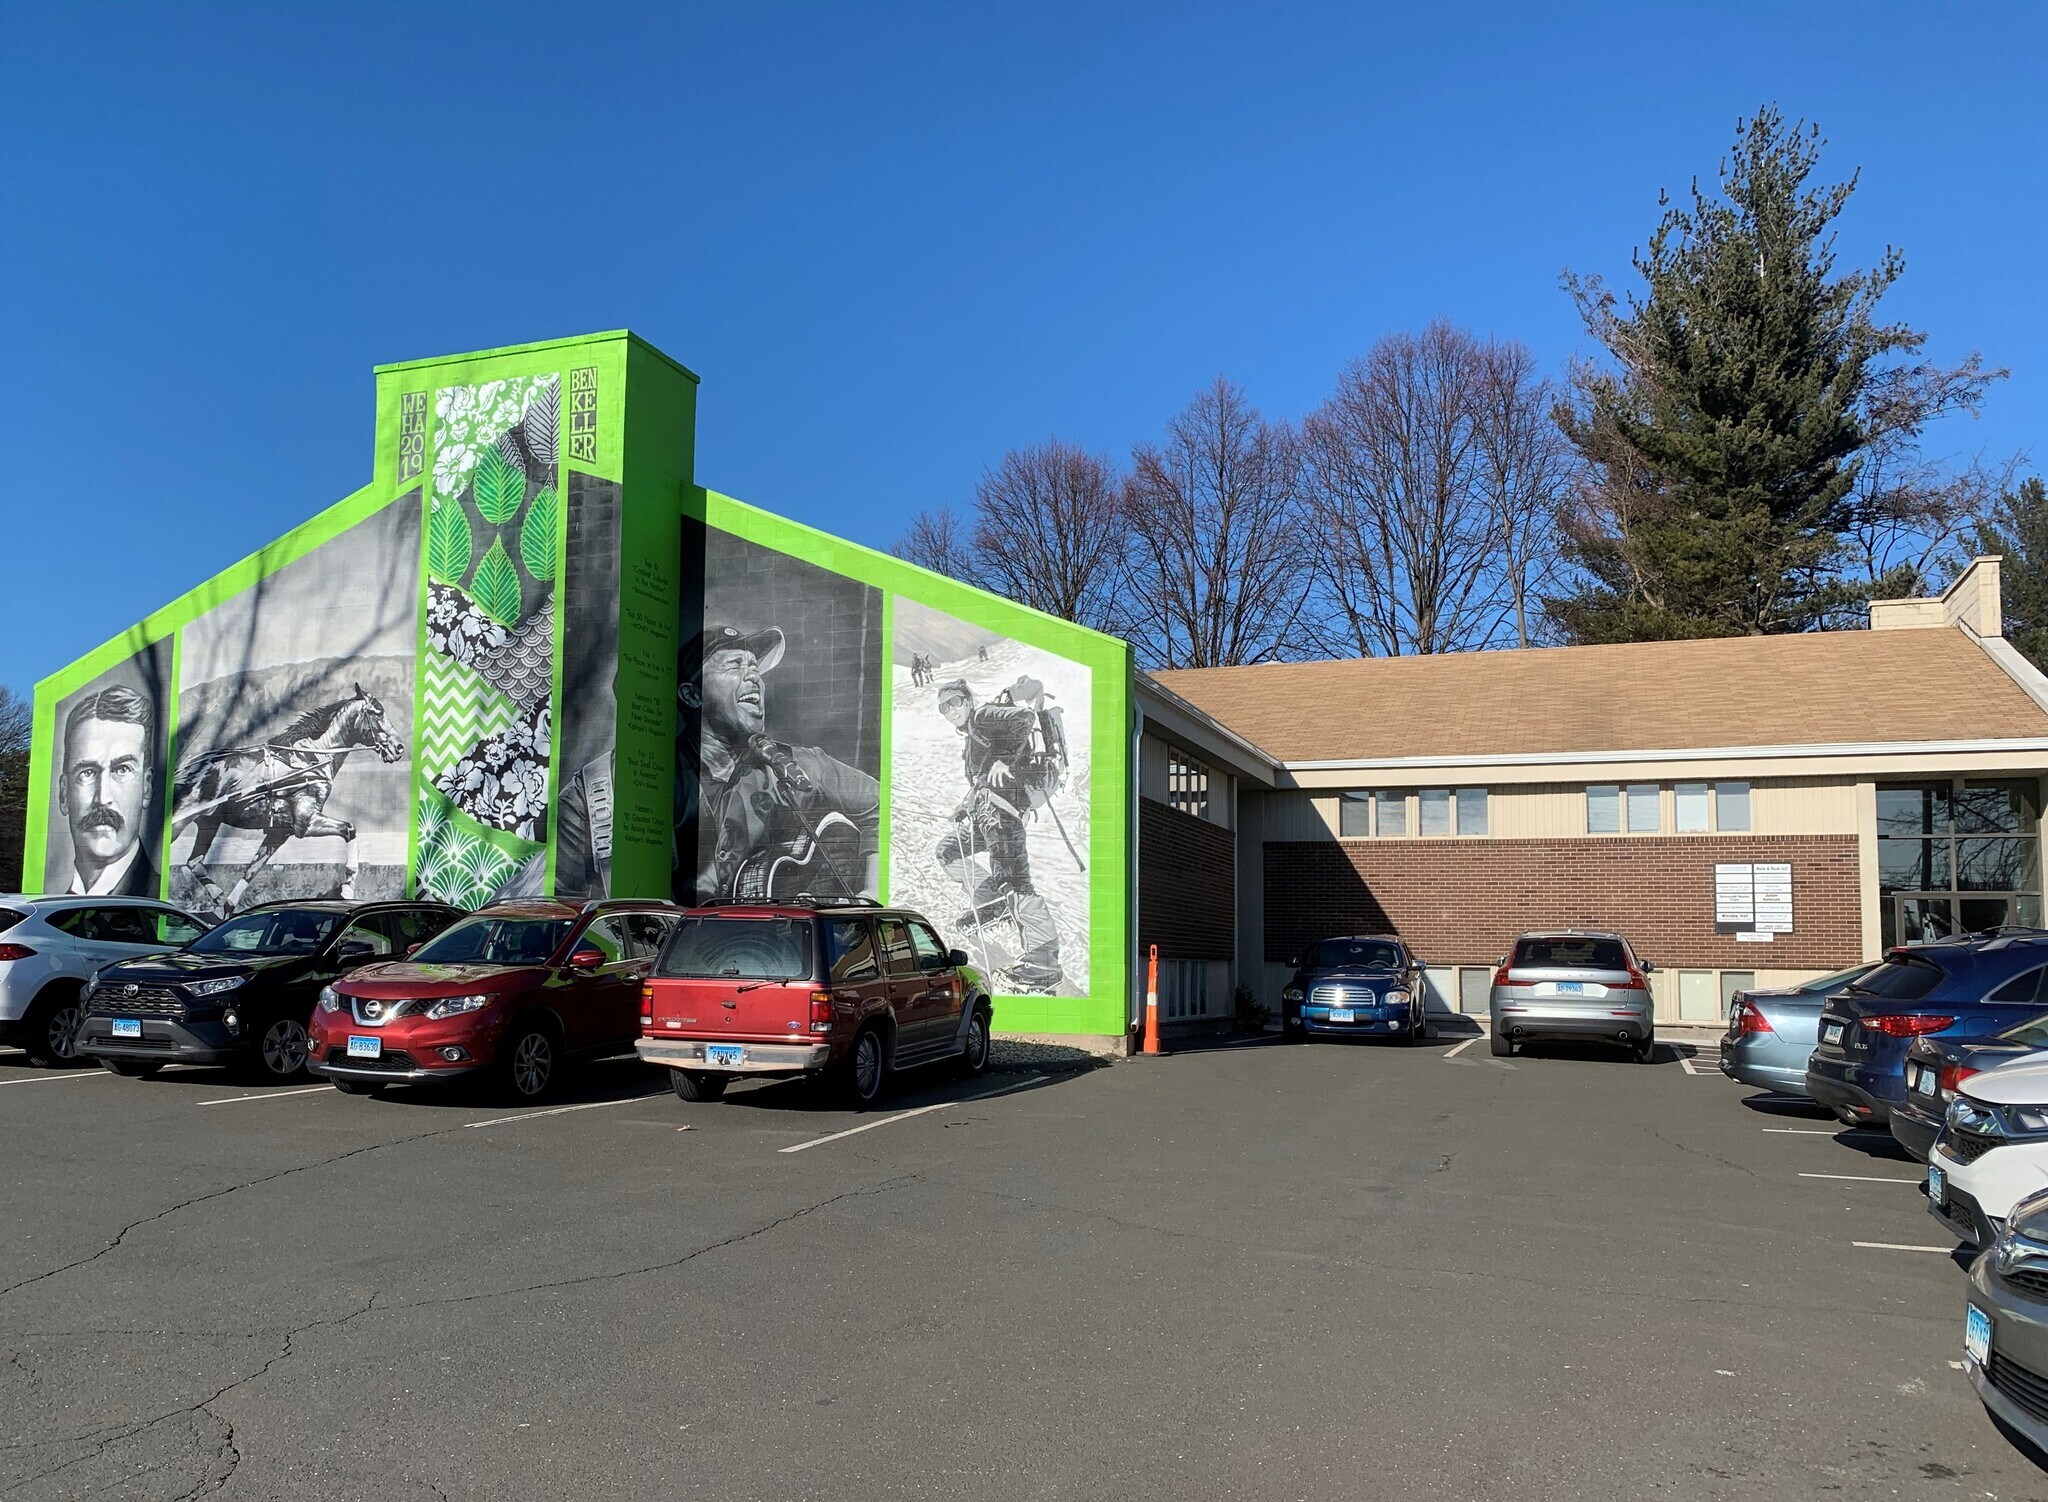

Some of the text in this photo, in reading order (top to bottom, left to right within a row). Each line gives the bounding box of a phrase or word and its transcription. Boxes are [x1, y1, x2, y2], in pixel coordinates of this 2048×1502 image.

[570, 367, 598, 391] BEN
[401, 392, 427, 415] WE
[570, 390, 596, 413] KE
[401, 413, 426, 435] HA
[570, 412, 596, 434] LL
[400, 433, 425, 456] 20
[569, 433, 596, 460] ER
[400, 453, 424, 482] 19
